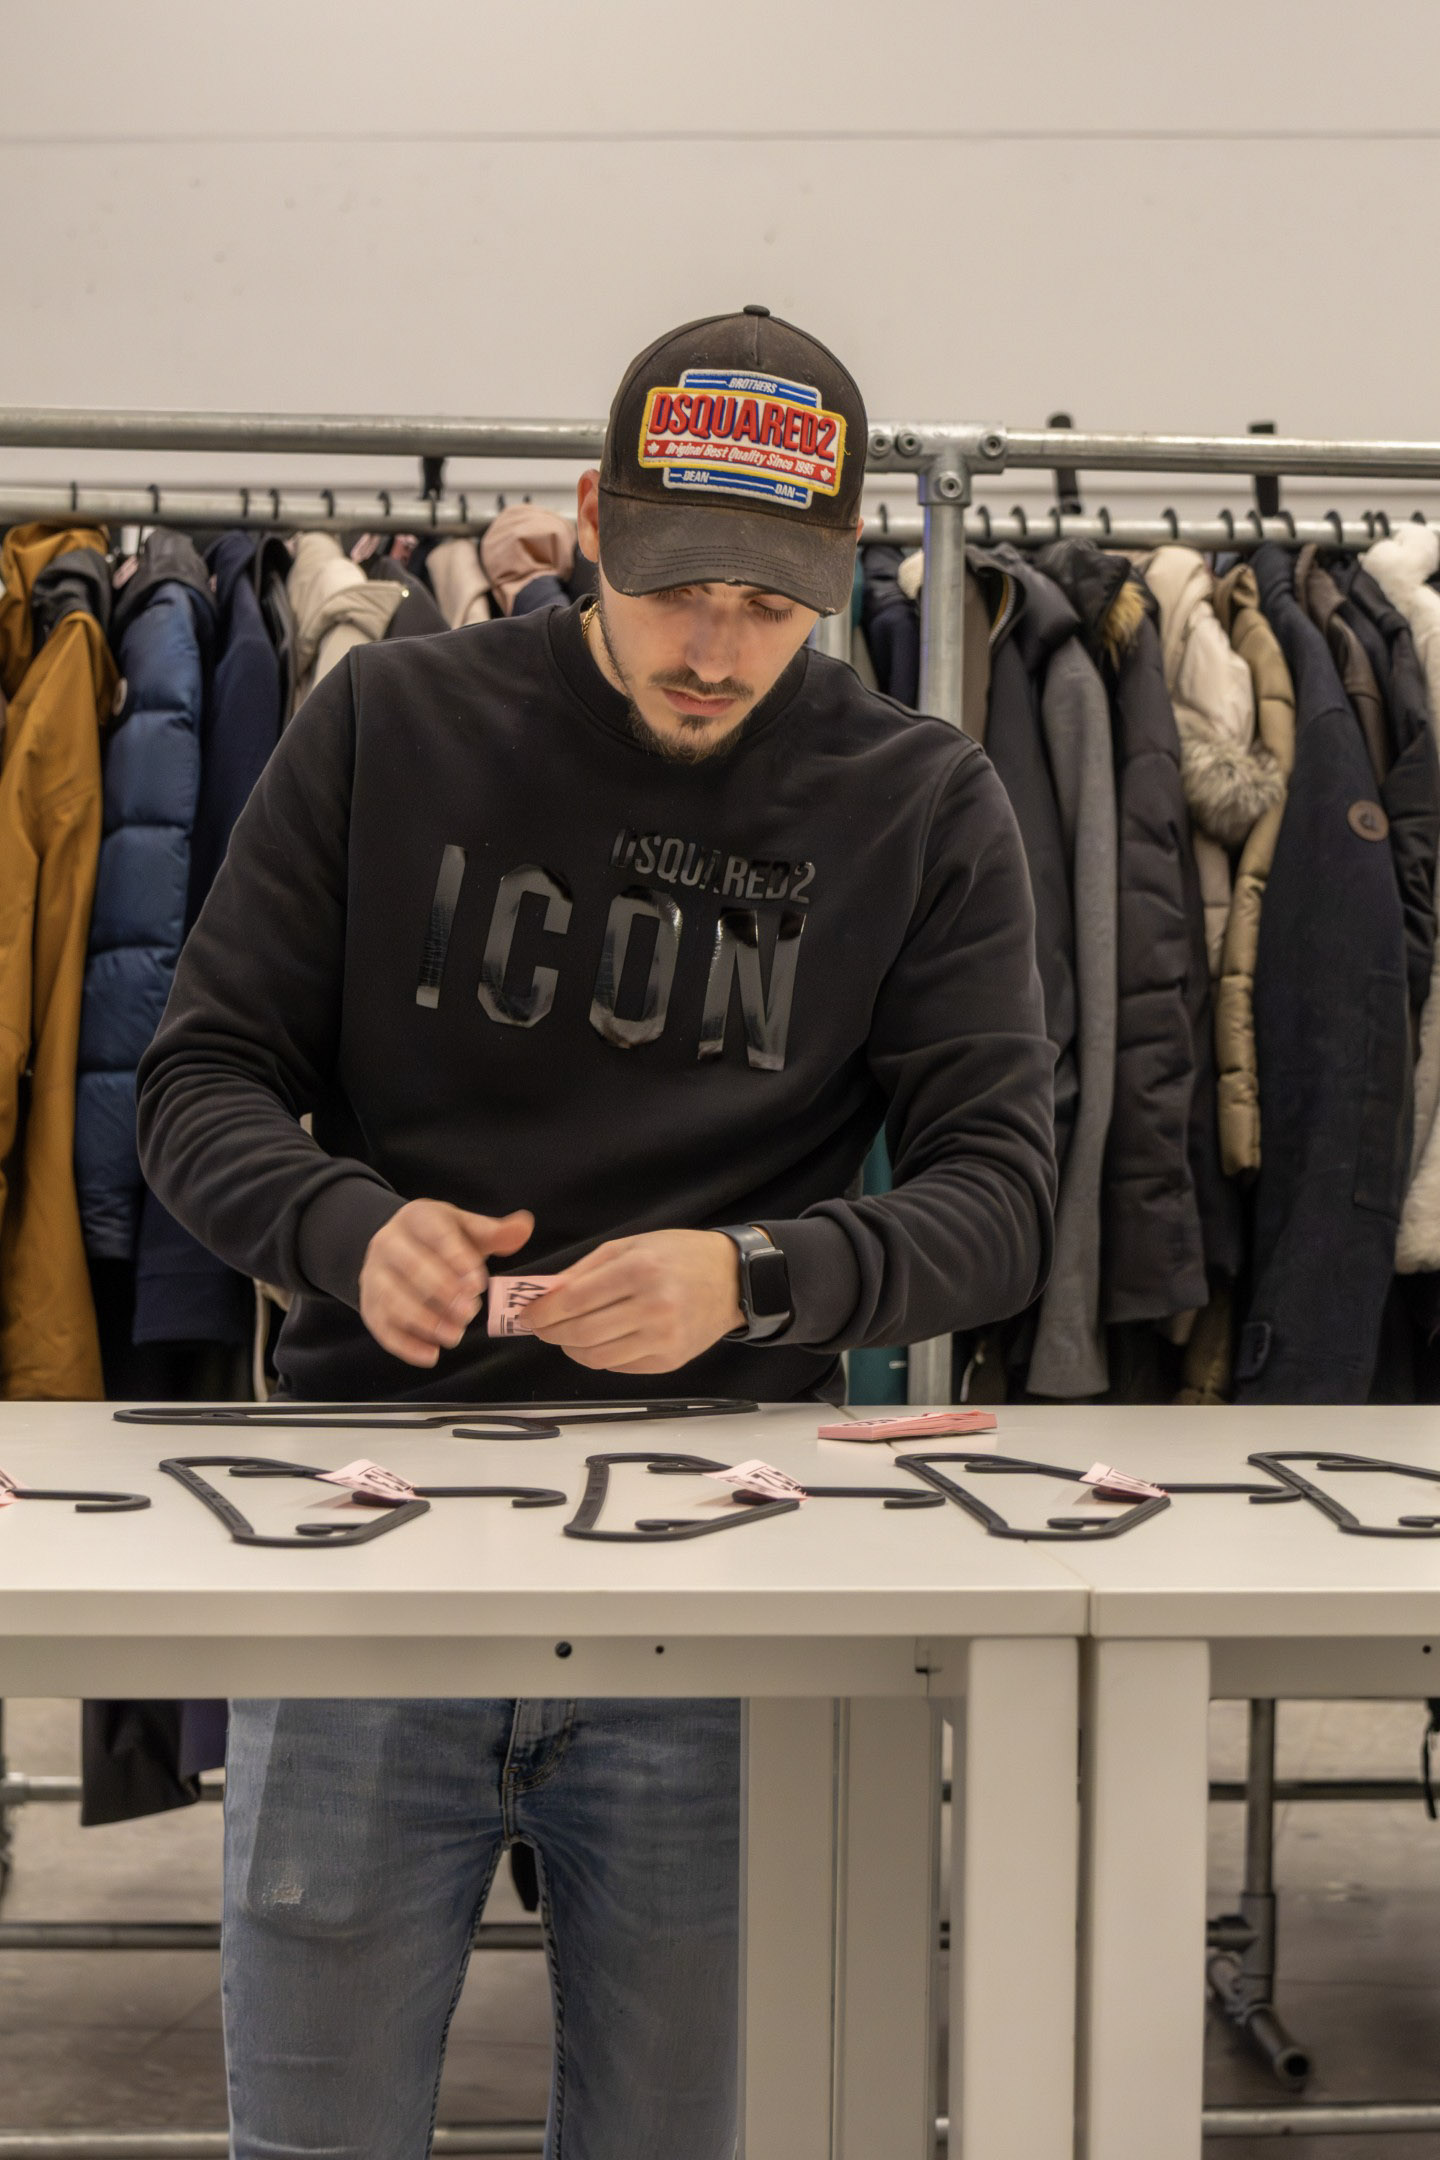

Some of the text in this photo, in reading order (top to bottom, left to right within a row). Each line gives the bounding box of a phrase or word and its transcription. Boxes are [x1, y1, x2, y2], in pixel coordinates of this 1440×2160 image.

[729, 377, 778, 394] BROTHERS
[649, 393, 837, 462] DSQUARED2
[665, 442, 704, 457] Original
[703, 444, 727, 459] Best
[727, 447, 766, 466] Quality
[767, 453, 794, 470] Since
[683, 470, 796, 498] DEAN DAN
[416, 844, 807, 1071] ICON
